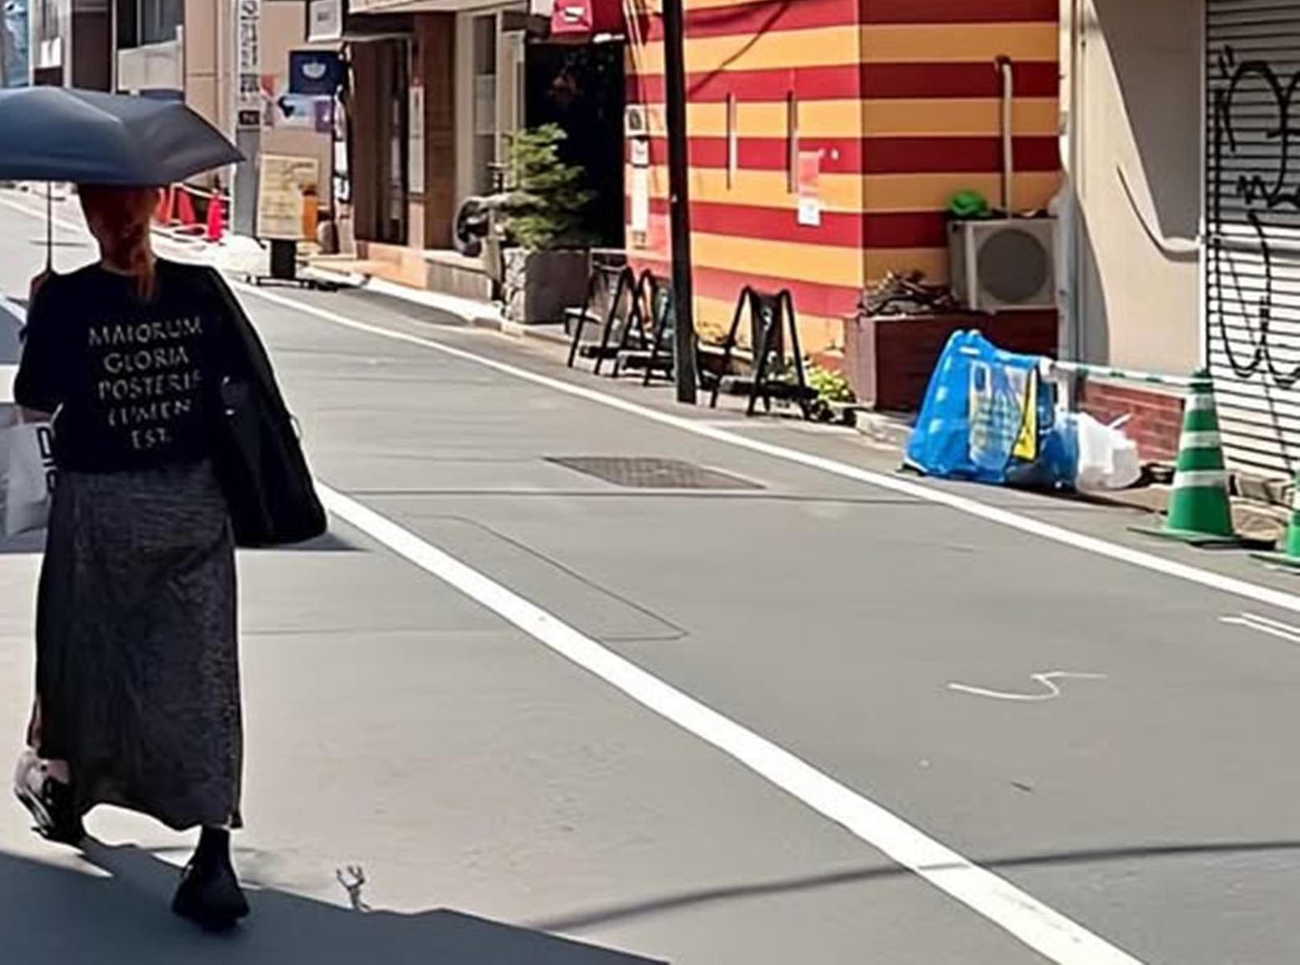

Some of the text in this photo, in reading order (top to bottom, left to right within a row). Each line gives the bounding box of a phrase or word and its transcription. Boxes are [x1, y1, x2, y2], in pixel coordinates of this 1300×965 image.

[88, 316, 203, 346] MAIORUM
[103, 346, 189, 374] GLORIA
[108, 399, 191, 426] LUMEN
